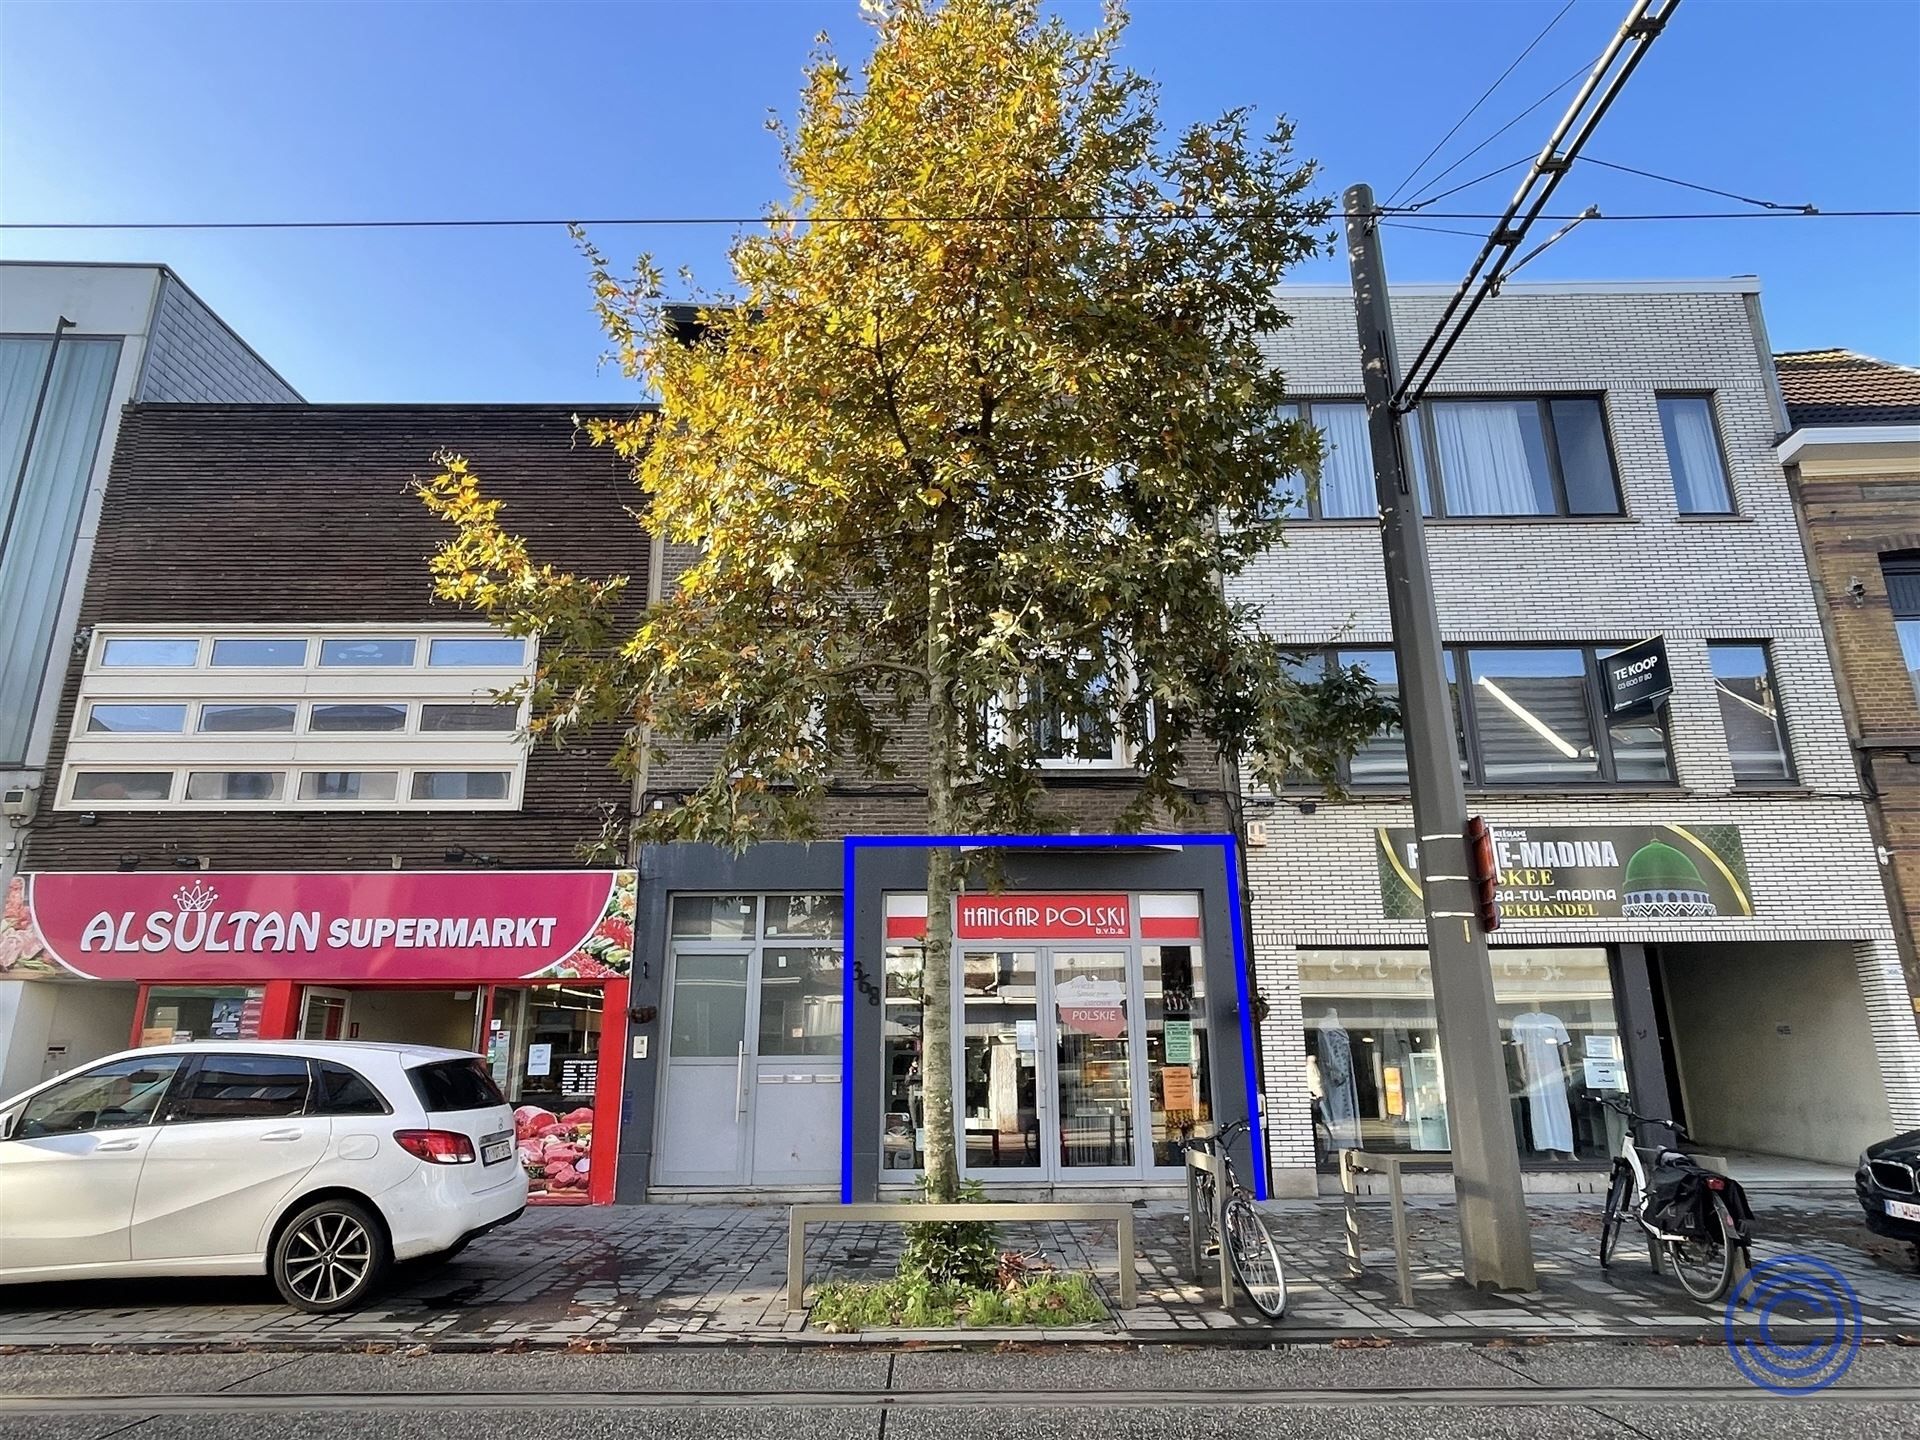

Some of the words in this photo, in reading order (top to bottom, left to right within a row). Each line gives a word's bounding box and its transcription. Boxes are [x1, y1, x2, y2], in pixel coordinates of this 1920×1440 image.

[1613, 667, 1628, 681] TE
[1628, 655, 1658, 676] KOOP
[963, 907, 1040, 927] HANGAR
[1045, 906, 1125, 927] POLSKI
[80, 911, 321, 952] ALSULTAN
[326, 917, 557, 949] SUPERMARKT
[852, 961, 880, 1006] 368
[1072, 1010, 1117, 1021] POLSKIE
